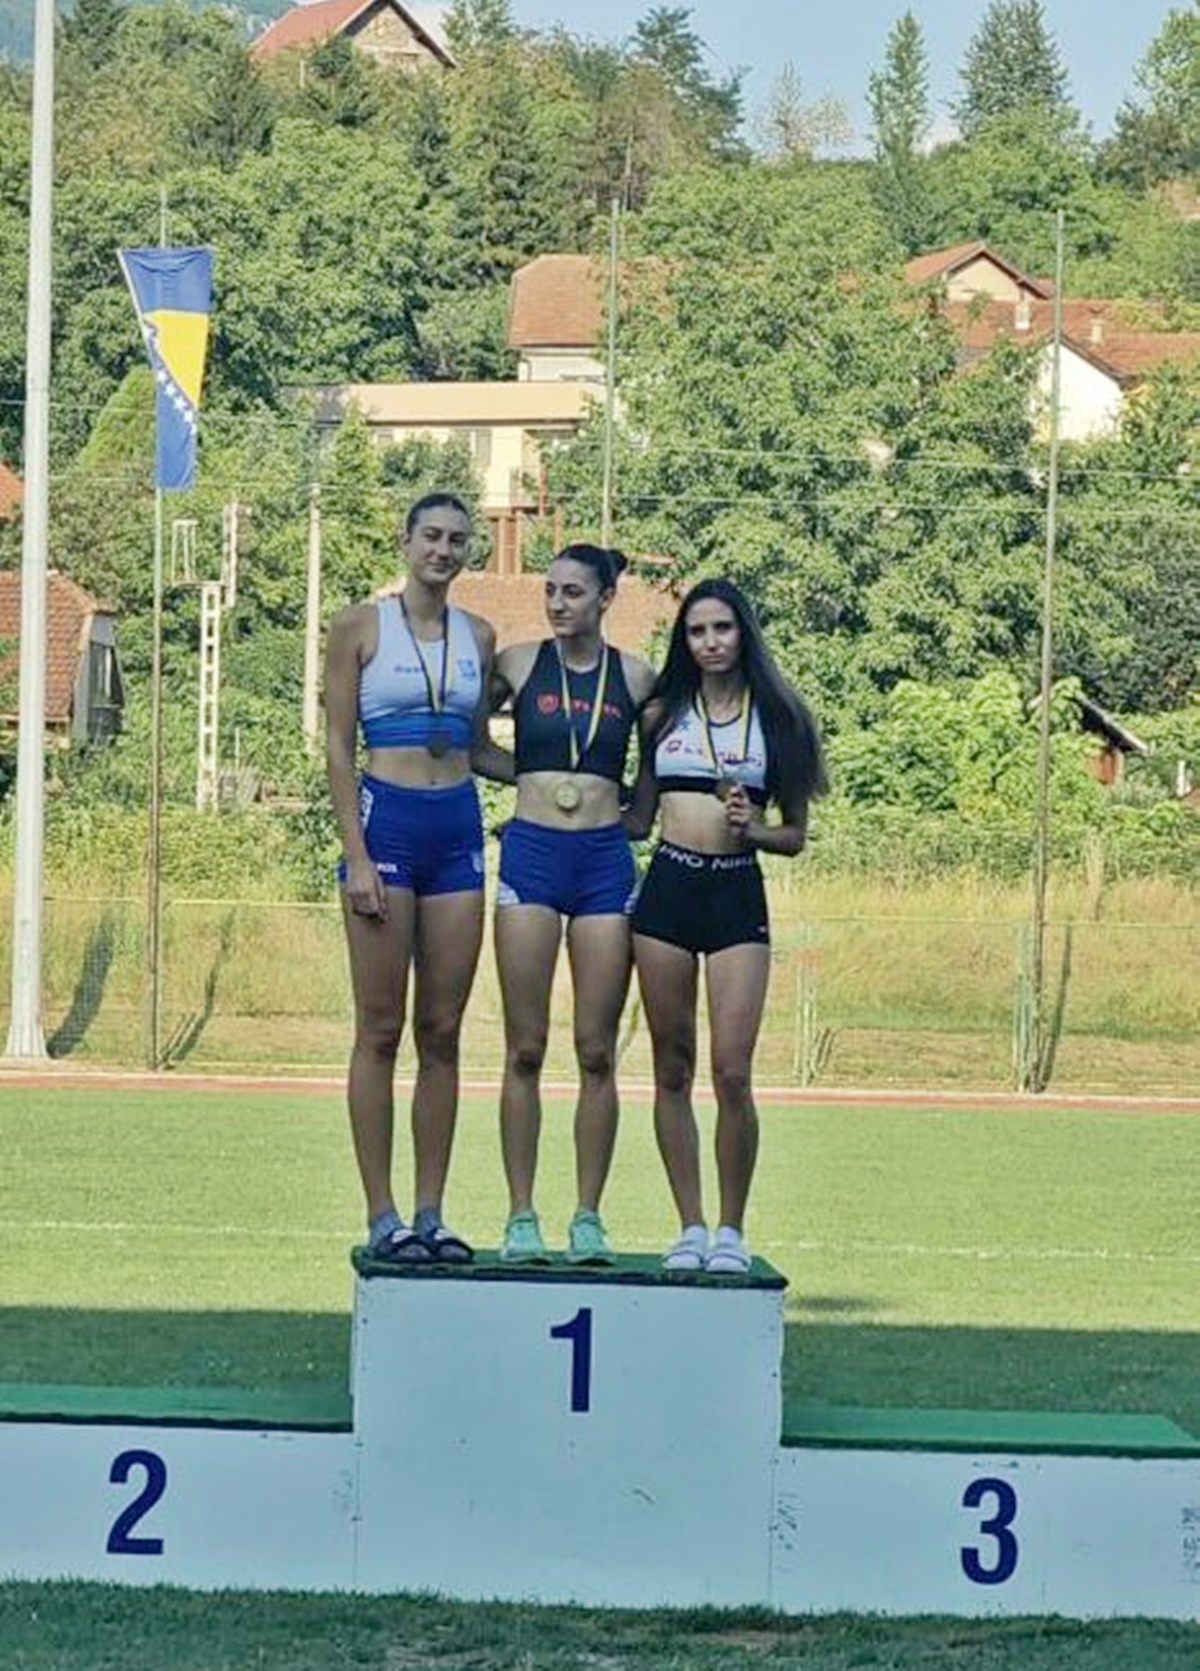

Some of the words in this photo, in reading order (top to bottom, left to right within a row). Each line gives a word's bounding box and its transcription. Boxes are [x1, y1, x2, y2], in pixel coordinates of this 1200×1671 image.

[550, 1307, 592, 1413] 1
[106, 1449, 167, 1556] 2
[960, 1477, 1019, 1585] 3
